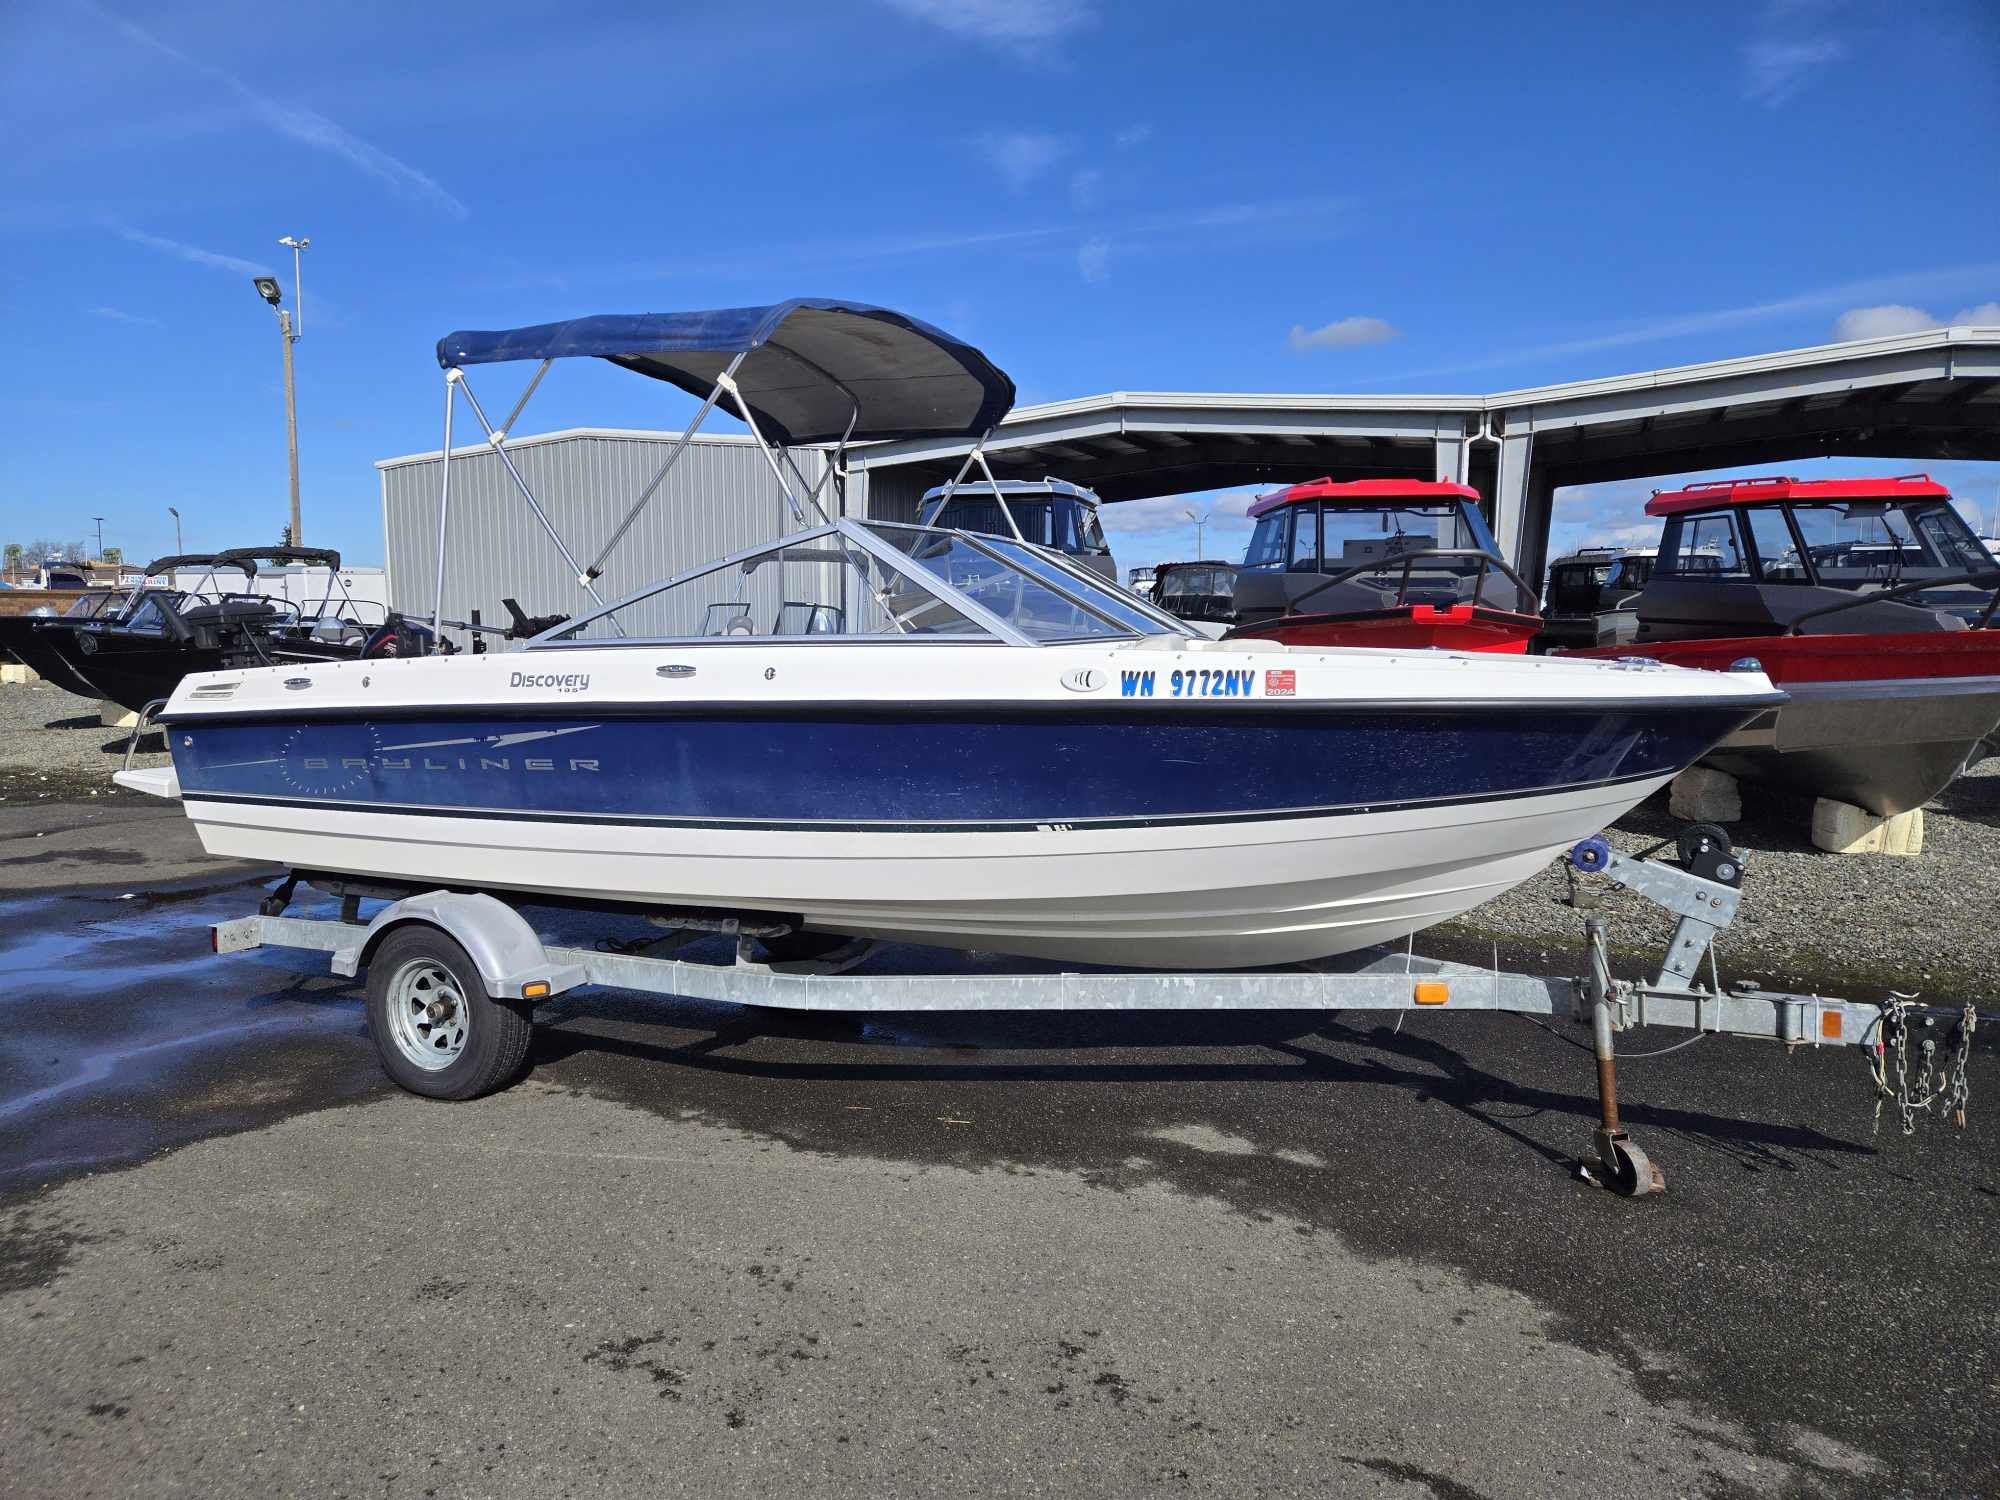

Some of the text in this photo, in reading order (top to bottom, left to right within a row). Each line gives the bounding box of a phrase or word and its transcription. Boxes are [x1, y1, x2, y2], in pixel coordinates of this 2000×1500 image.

[1121, 670, 1156, 697] WN
[1170, 669, 1256, 697] 9772NV
[303, 758, 601, 771] BAYLINER
